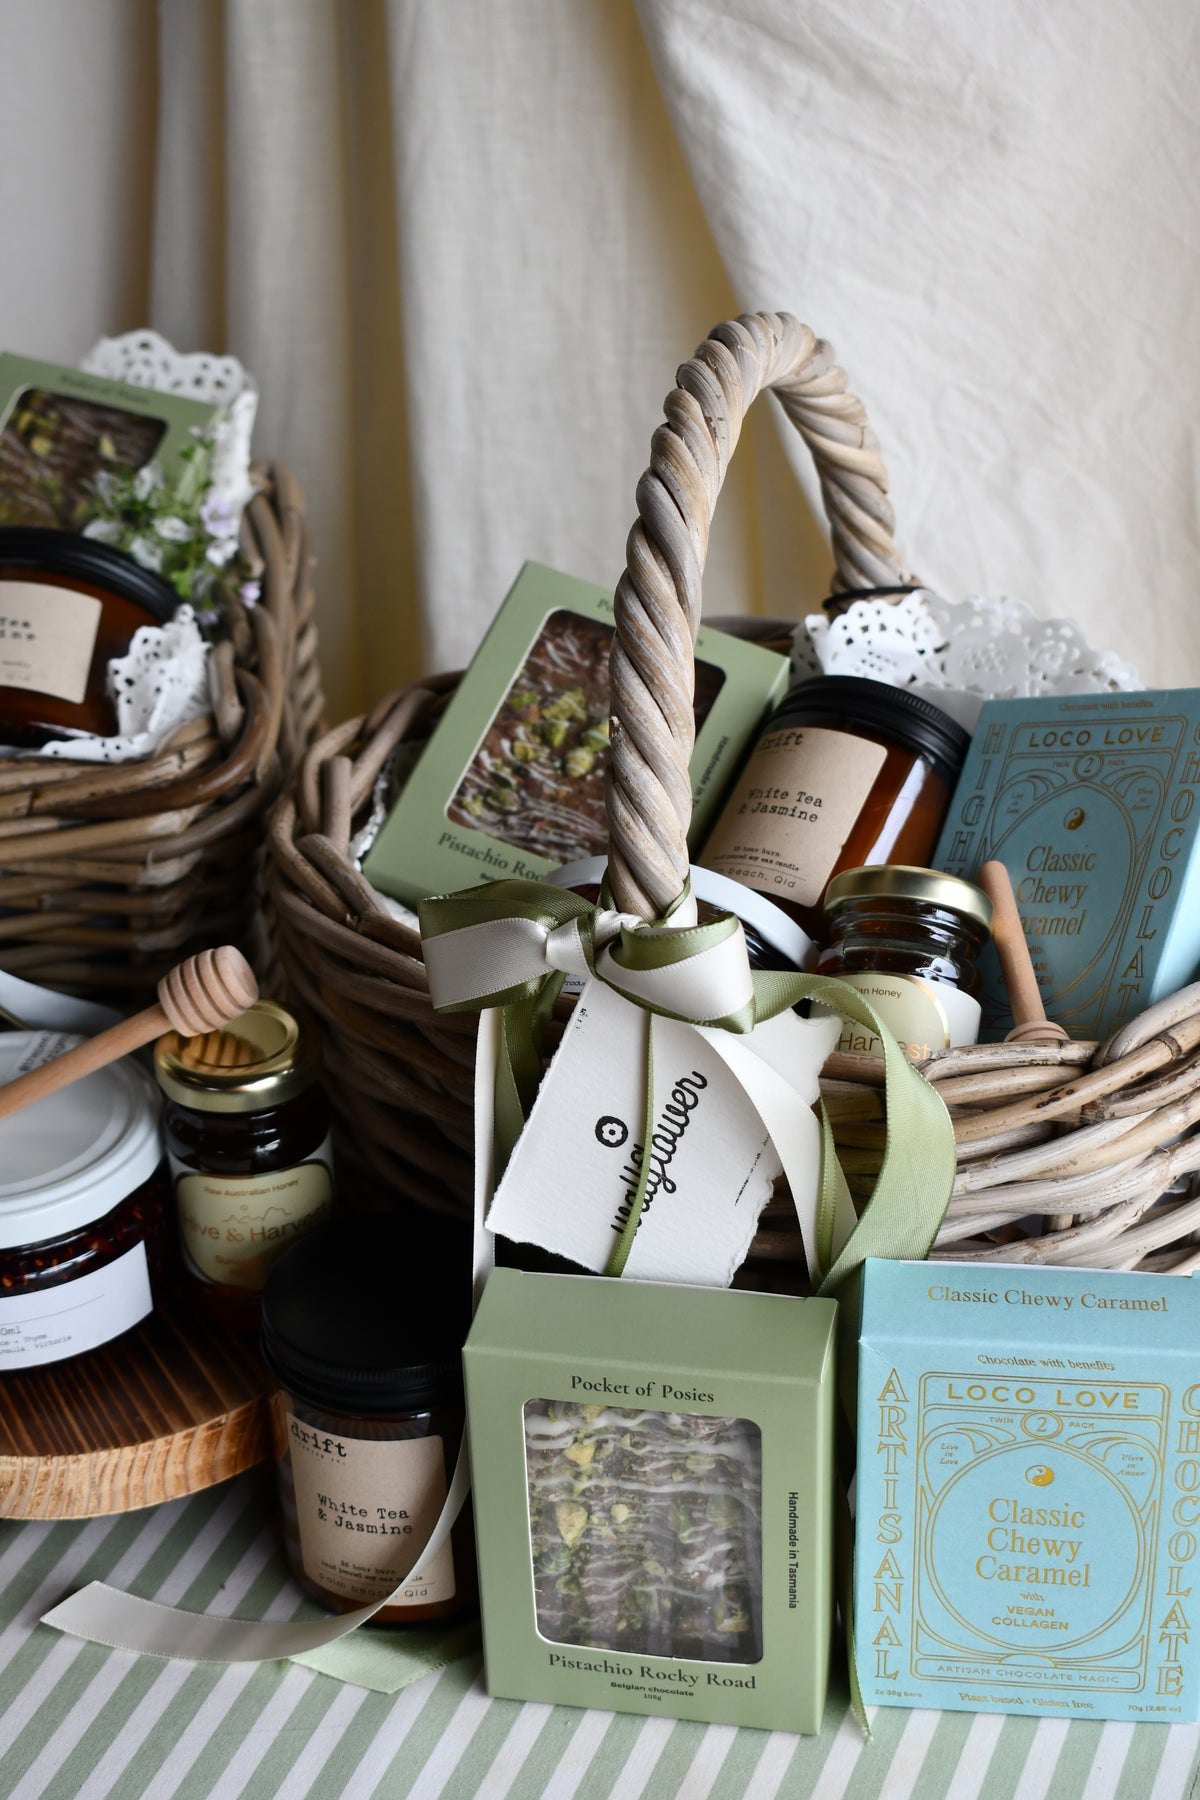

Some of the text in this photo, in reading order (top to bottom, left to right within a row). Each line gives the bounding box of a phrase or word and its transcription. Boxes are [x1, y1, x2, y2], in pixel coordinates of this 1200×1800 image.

[1028, 726, 1165, 748] LOCO LOVE
[1083, 756, 1094, 773] 2
[747, 787, 823, 807] White Tea
[751, 802, 818, 822] Jasmine
[438, 830, 508, 870] Pistachio
[761, 848, 780, 858] burn
[1026, 844, 1097, 872] Classic
[775, 859, 800, 872] candle
[774, 876, 796, 888] Qld
[1107, 722, 1200, 1034] HOCOLAT
[1015, 877, 1088, 909] Chewy
[1020, 909, 1087, 936] aramel
[871, 987, 902, 999] Honey
[837, 1032, 930, 1060] Harest
[223, 1186, 271, 1198] Australian
[272, 1178, 299, 1192] Honey
[226, 1227, 245, 1242] &
[927, 1284, 1169, 1312] Classic Chewy Caramel
[35, 1335, 72, 1349] Victoria
[977, 1353, 1116, 1371] Chocolate with benefits
[570, 1374, 715, 1403] Pocket of Posies
[947, 1383, 1140, 1410] LOCO LOVE
[988, 1416, 1095, 1432] TWIN 2 PACK
[290, 1421, 347, 1458] drift
[316, 1492, 410, 1520] White Tea
[988, 1497, 1086, 1529] Classic
[318, 1507, 413, 1535] & Jasmine
[872, 1367, 910, 1681] ARTISANAL
[788, 1490, 799, 1609] Handmade in Tasmania
[986, 1527, 1083, 1564] Chewy
[338, 1567, 361, 1578] poured
[352, 1563, 372, 1574] hour
[375, 1567, 397, 1575] burn
[975, 1556, 1091, 1588] Caramel
[319, 1572, 346, 1589] palm
[404, 1588, 428, 1600] Qld
[1018, 1592, 1045, 1602] with
[1006, 1605, 1055, 1618] VEGAN
[991, 1616, 1069, 1631] COLLAGEN
[548, 1653, 757, 1690] Pistachio Rocky Road
[936, 1664, 1121, 1684] ARTISAN CHOCOLATE MAGIC
[610, 1681, 694, 1697] Belgian chocolate
[958, 1692, 1095, 1710] Plant based Gluten free
[1127, 1704, 1143, 1713] 70g
